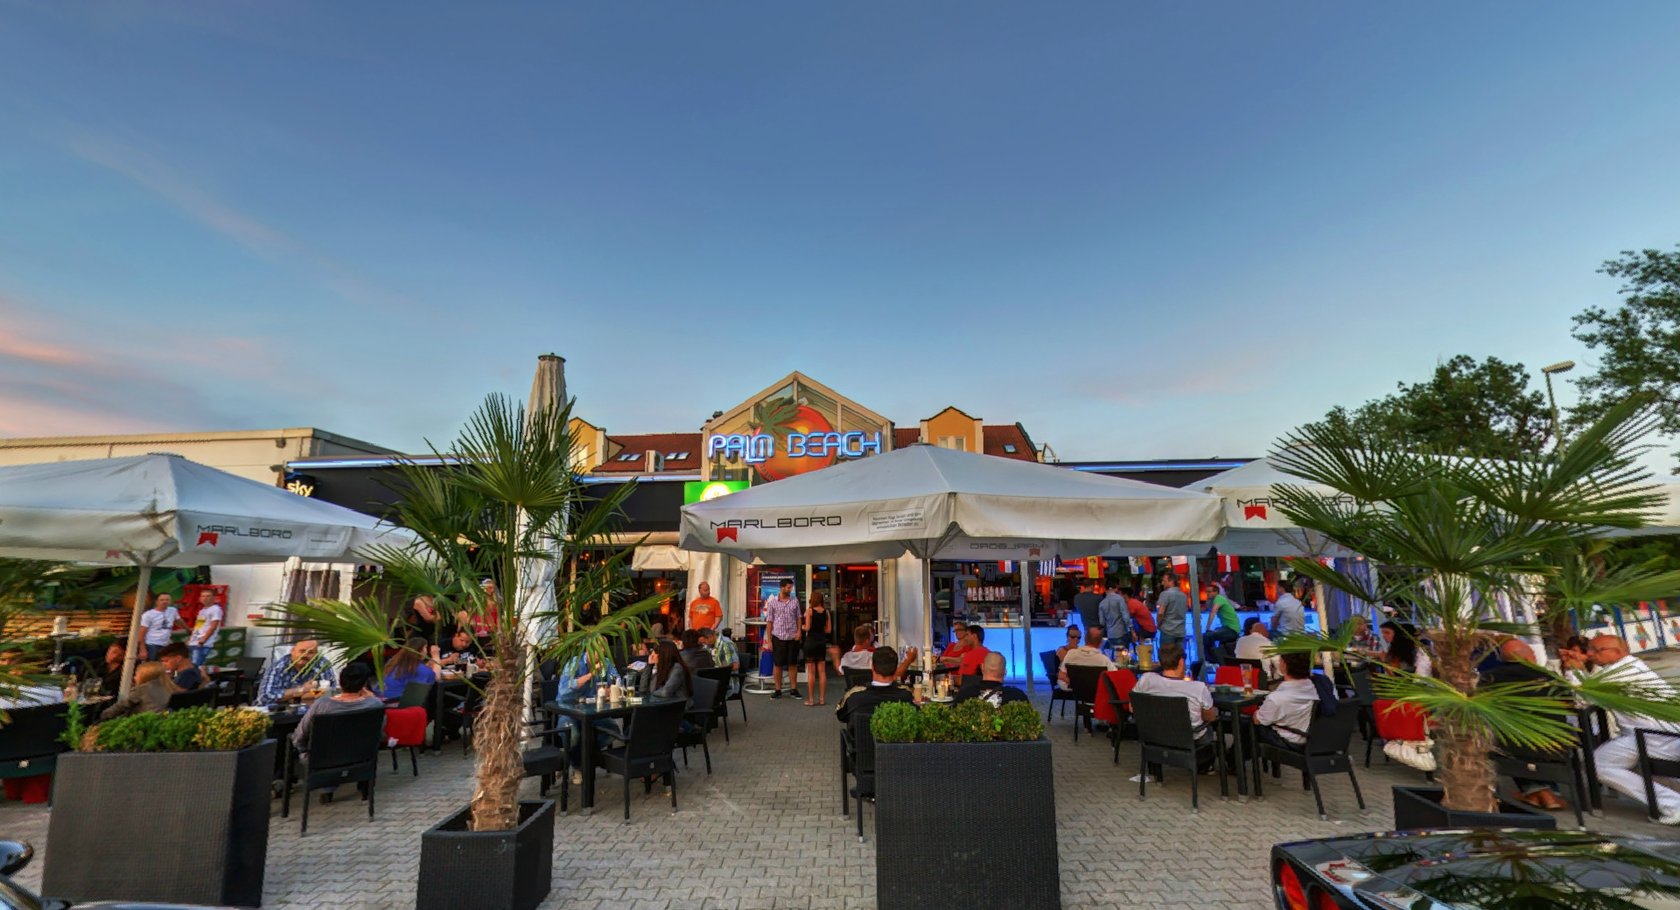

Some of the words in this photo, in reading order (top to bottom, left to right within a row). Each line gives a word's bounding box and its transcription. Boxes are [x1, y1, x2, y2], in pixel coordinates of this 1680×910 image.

[707, 433, 775, 463] PALM
[787, 431, 882, 458] BEACH
[287, 480, 314, 497] sky
[710, 515, 842, 530] MARLBORO
[196, 524, 293, 540] MARLBORO
